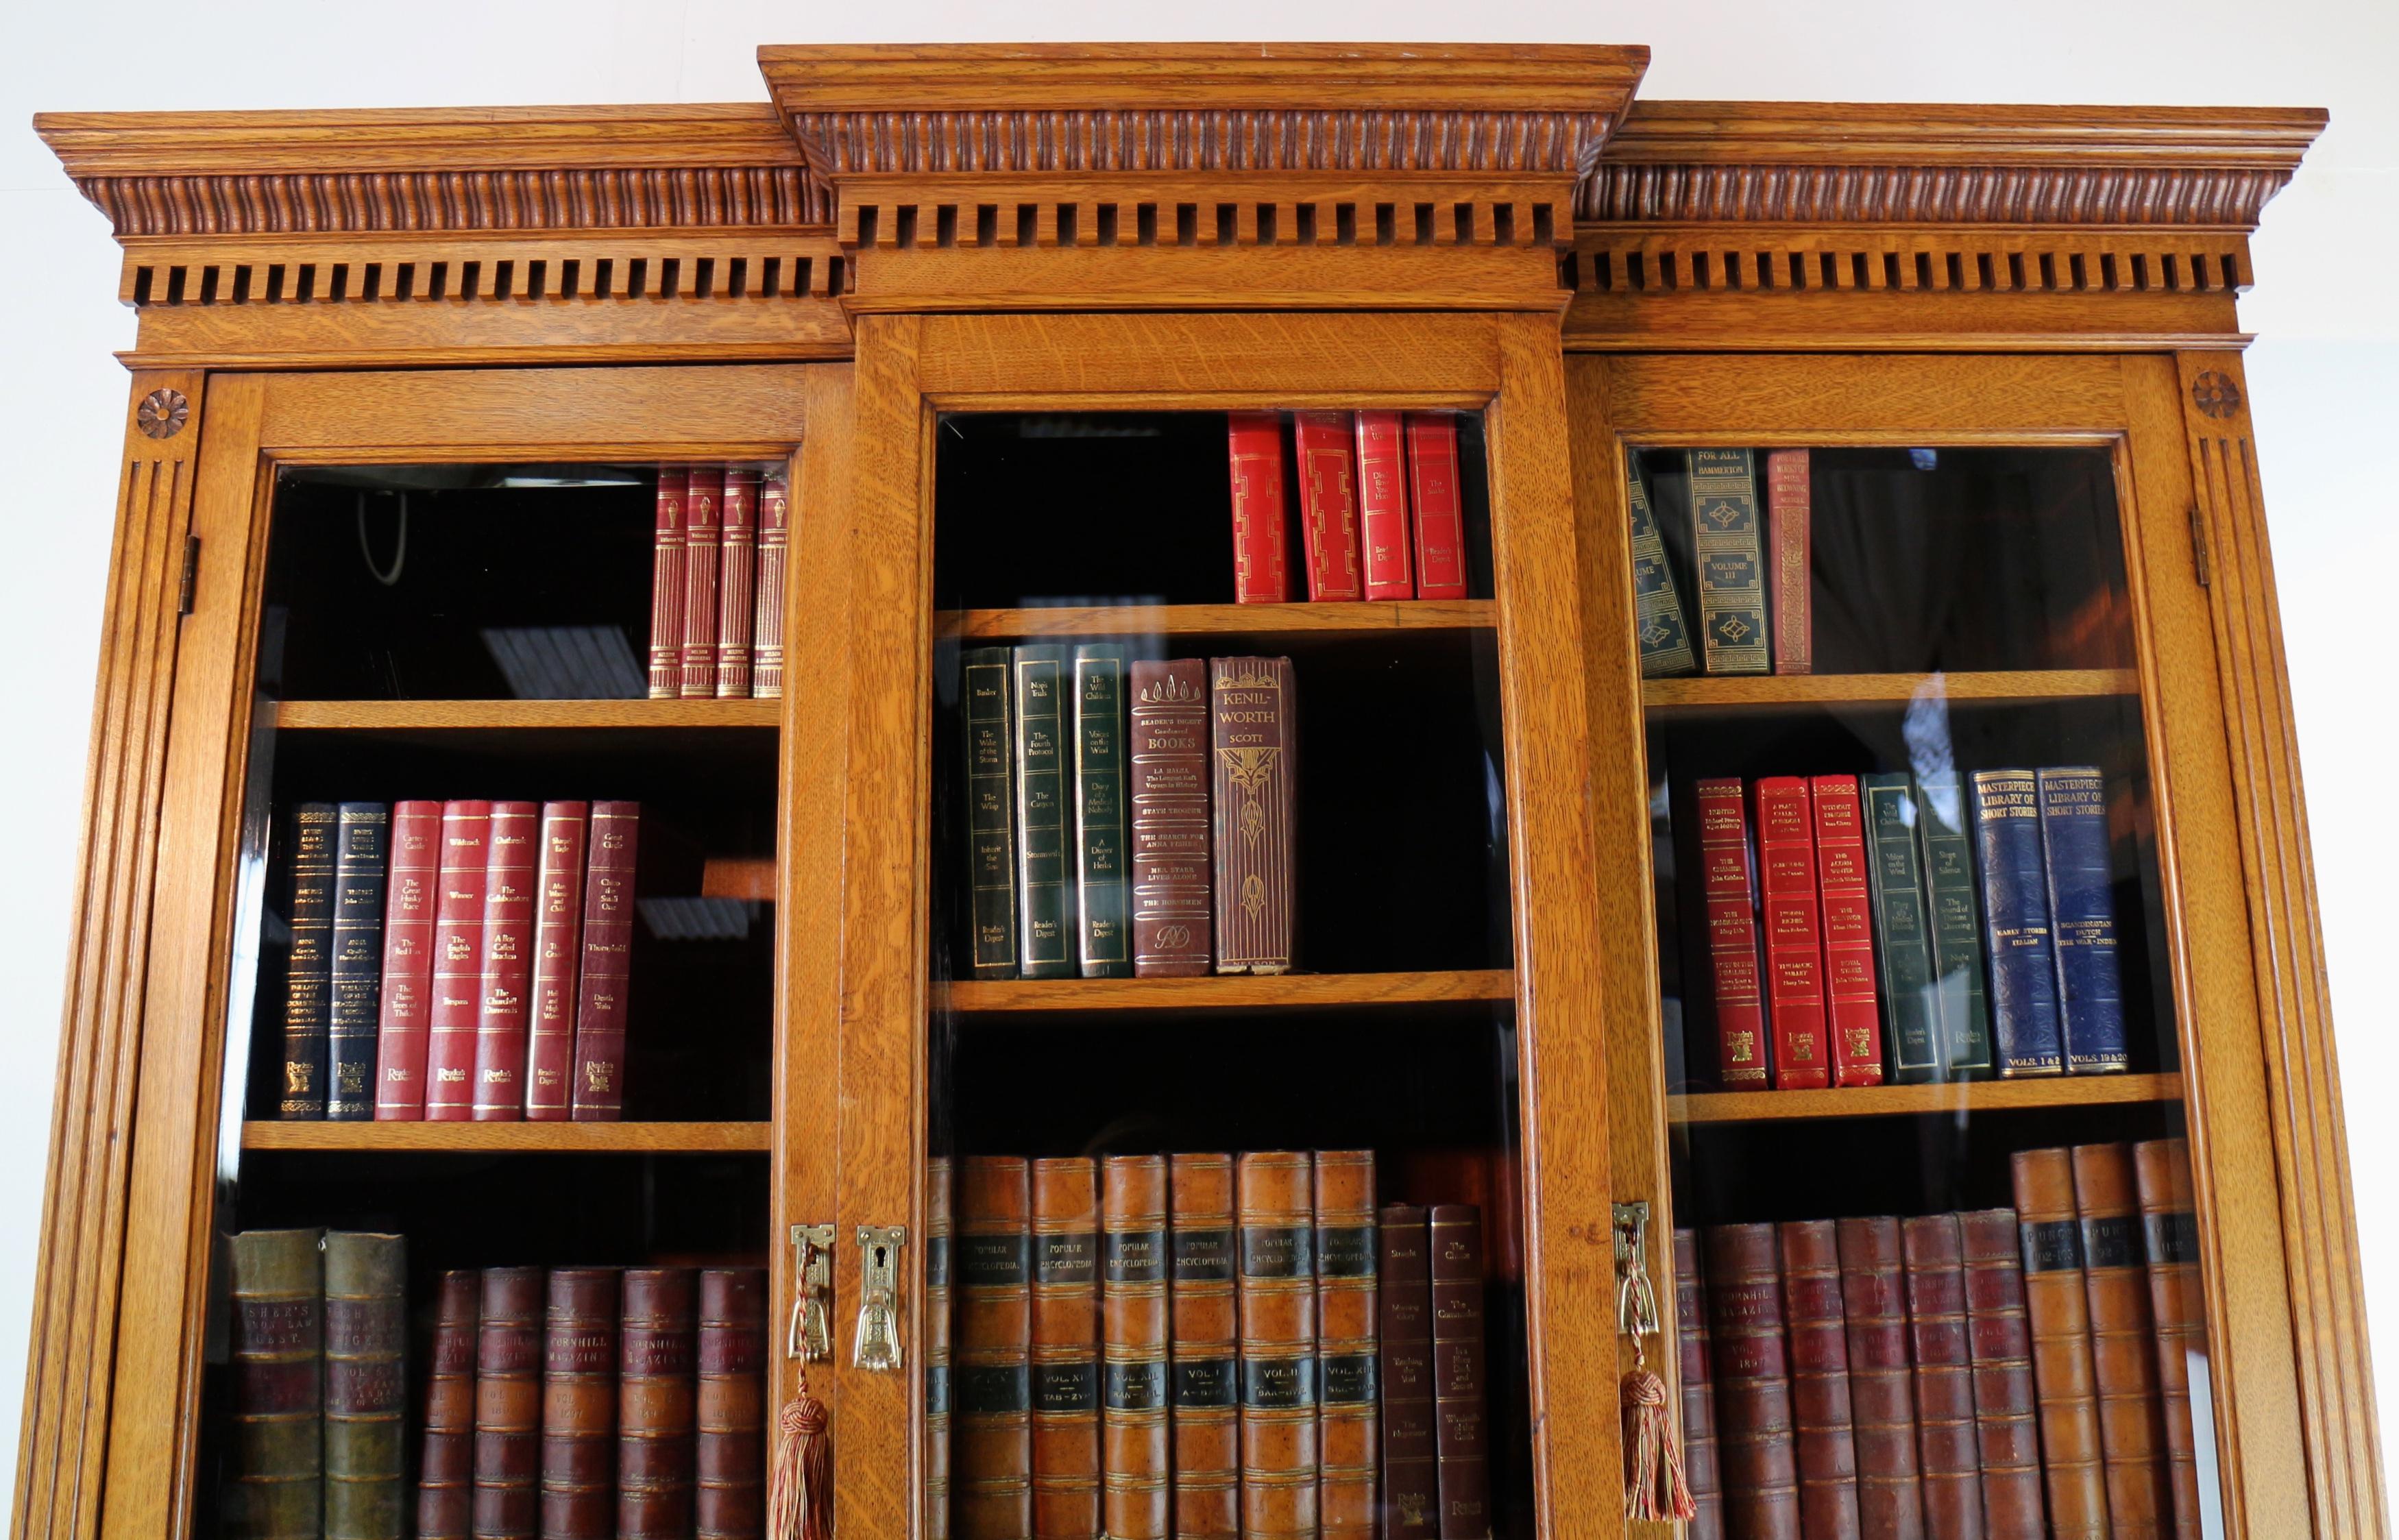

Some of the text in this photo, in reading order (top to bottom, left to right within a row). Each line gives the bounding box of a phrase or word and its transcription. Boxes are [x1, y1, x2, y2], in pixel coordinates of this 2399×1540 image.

[1698, 451, 1740, 460] FOR ALL
[1698, 466, 1743, 474] HAMMERTON
[1223, 693, 1271, 705] KENIL-
[1219, 711, 1274, 724] WORTH
[1149, 738, 1195, 749] BOOKS
[1230, 734, 1263, 743] SCOTT
[1977, 781, 2035, 794] MASTERPIECE
[2045, 779, 2102, 791] MASTERPIECE
[1982, 794, 2034, 806] LIBRARY OF
[2049, 792, 2102, 803] LIBRARY OF
[1981, 807, 2037, 820] SHORT STORIES
[2047, 805, 2105, 816] SHORT STORIES
[1036, 929, 1055, 938] Digest
[502, 935, 515, 943] Boy
[1119, 1243, 1149, 1251] POPULAR
[1262, 1239, 1293, 1247] POPULAR
[1050, 1245, 1082, 1253] POPULAR
[551, 1337, 607, 1347] CORNHILL
[1044, 1374, 1069, 1382] VOL.
